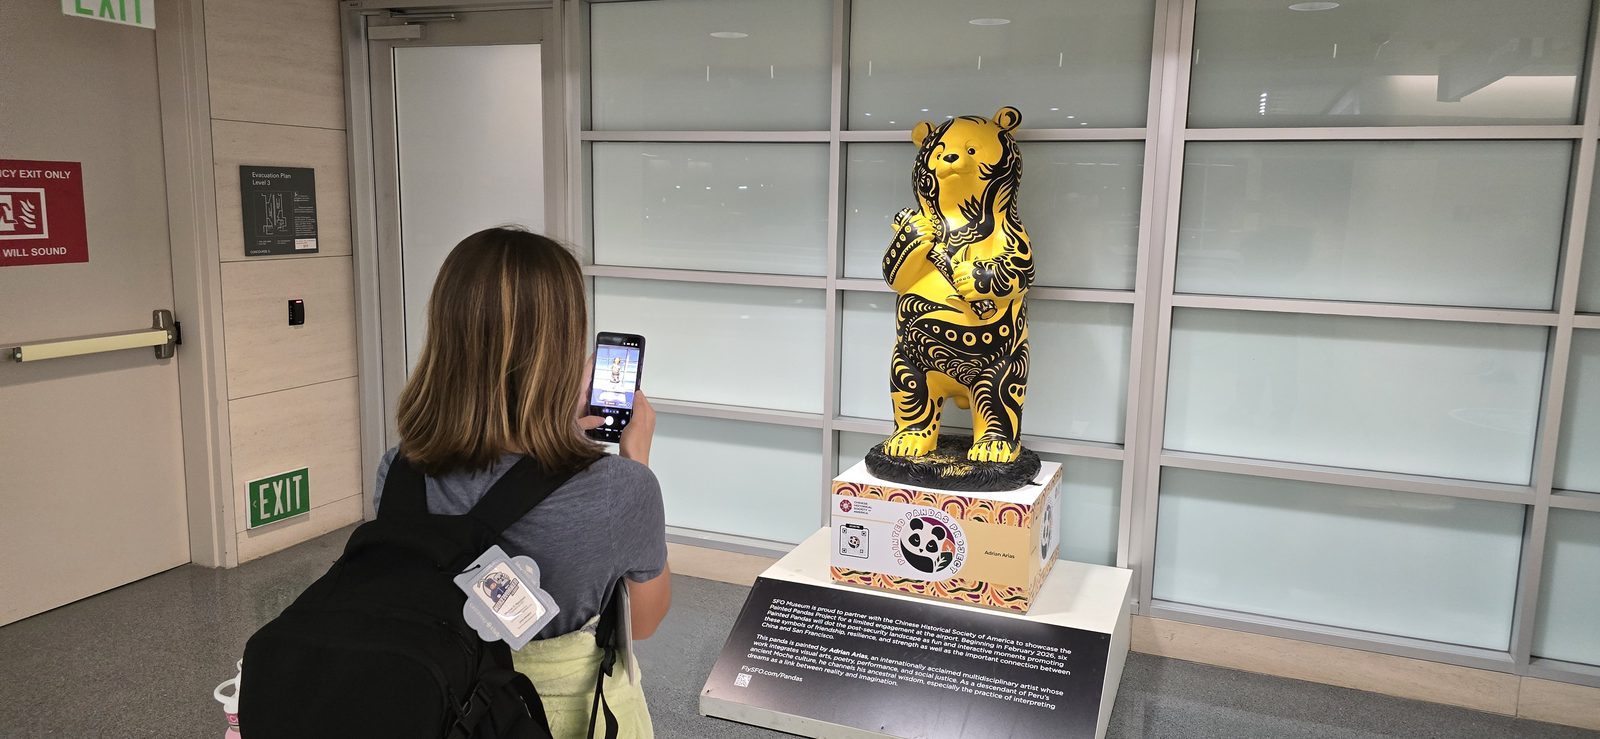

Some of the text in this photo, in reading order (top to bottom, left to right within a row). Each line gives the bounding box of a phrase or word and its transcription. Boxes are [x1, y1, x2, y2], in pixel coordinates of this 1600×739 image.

[20, 170, 41, 178] EXIT
[3, 247, 67, 257] WILL SOUND
[259, 475, 302, 520] EXIT
[892, 508, 965, 574] PAINTED PANDAS PROJECT
[766, 610, 790, 618] Painted
[790, 614, 812, 622] Pandas
[846, 625, 889, 637] post-security
[889, 632, 922, 642] landscape
[957, 644, 993, 654] interactive
[993, 651, 1027, 660] moments
[1027, 657, 1065, 668] promoting
[785, 601, 811, 609] Museum
[894, 620, 920, 628] Chinese
[920, 624, 951, 633] Historical
[951, 629, 977, 639] Society
[986, 635, 1015, 644] America
[1025, 642, 1059, 652] showcase
[804, 630, 835, 639] Francisco.
[814, 625, 847, 635] friendship,
[847, 632, 878, 641] resilience,
[892, 640, 920, 648] strength
[965, 652, 999, 662] important
[1000, 659, 1039, 669] connection
[1040, 665, 1071, 675] between
[852, 619, 875, 627] limited
[875, 624, 915, 634] engagement
[961, 638, 995, 649] Beginning
[1004, 645, 1035, 656] February
[1036, 651, 1057, 659] 2026,
[741, 665, 803, 682] FlySFO.com/Pandas
[747, 653, 770, 661] dreams
[796, 662, 823, 672] between
[824, 668, 844, 677] reality
[858, 674, 899, 686] imagination.
[750, 647, 773, 655] ancient
[773, 651, 794, 659] Moche
[794, 656, 818, 664] culture,
[827, 662, 856, 671] channels
[867, 670, 897, 679] ancestral
[897, 675, 926, 685] wisdom,
[926, 681, 960, 692] especially
[974, 690, 1003, 699] practice
[1013, 696, 1056, 710] interpreting
[769, 643, 800, 653] integrates
[833, 656, 856, 664] poetry,
[856, 661, 900, 672] performance,
[934, 675, 959, 683] justice.
[976, 682, 1018, 694] descendant
[794, 642, 819, 650] painted
[828, 648, 851, 656] Adrian
[851, 652, 870, 660] Arias,
[880, 657, 926, 671] internationally
[927, 667, 962, 676] acclaimed
[962, 673, 1019, 688] multidisciplinary
[1040, 688, 1064, 696] whose
